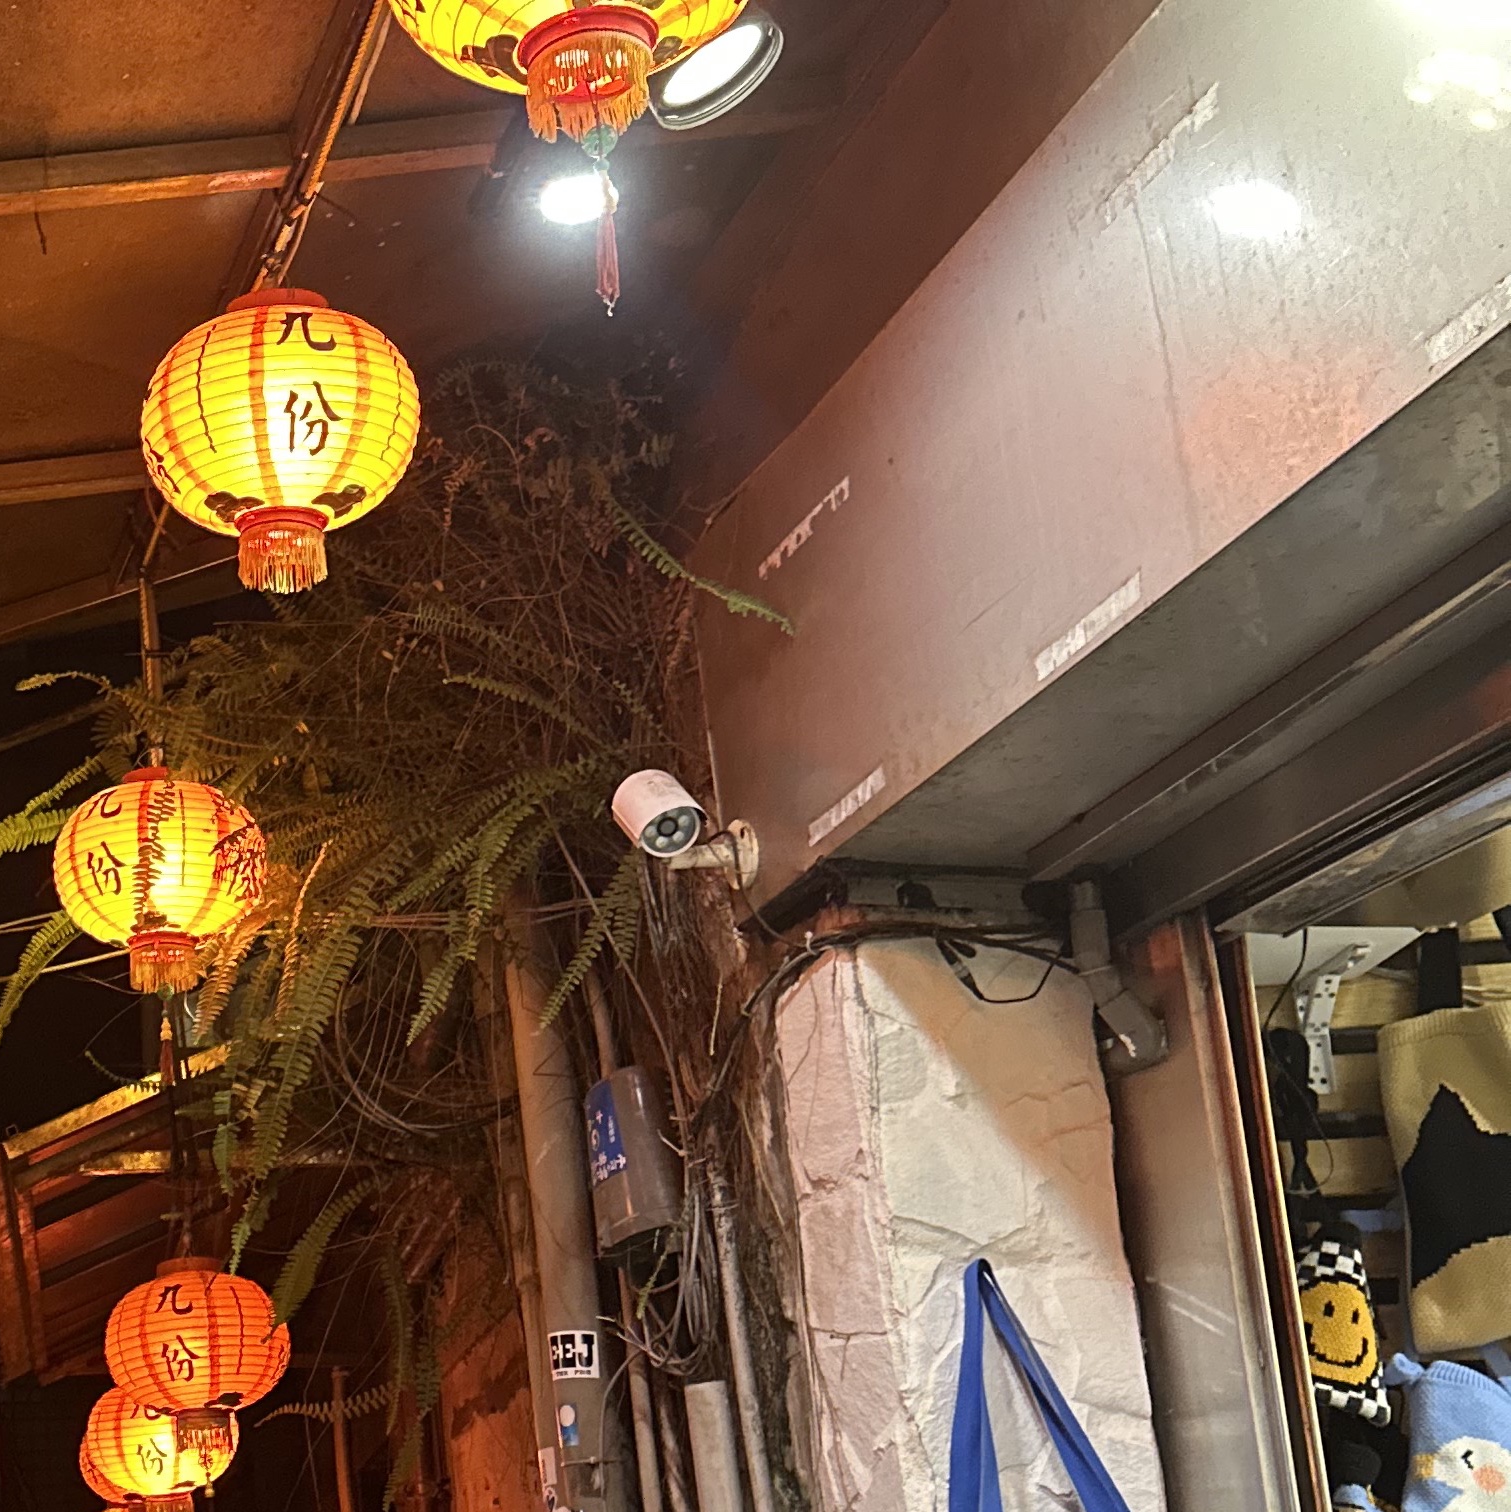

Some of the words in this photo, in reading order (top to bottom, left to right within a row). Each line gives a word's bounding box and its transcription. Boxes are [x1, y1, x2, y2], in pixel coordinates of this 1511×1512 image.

[276, 312, 342, 456] 九份
[86, 790, 125, 895] 九份
[155, 1284, 199, 1381] 九份
